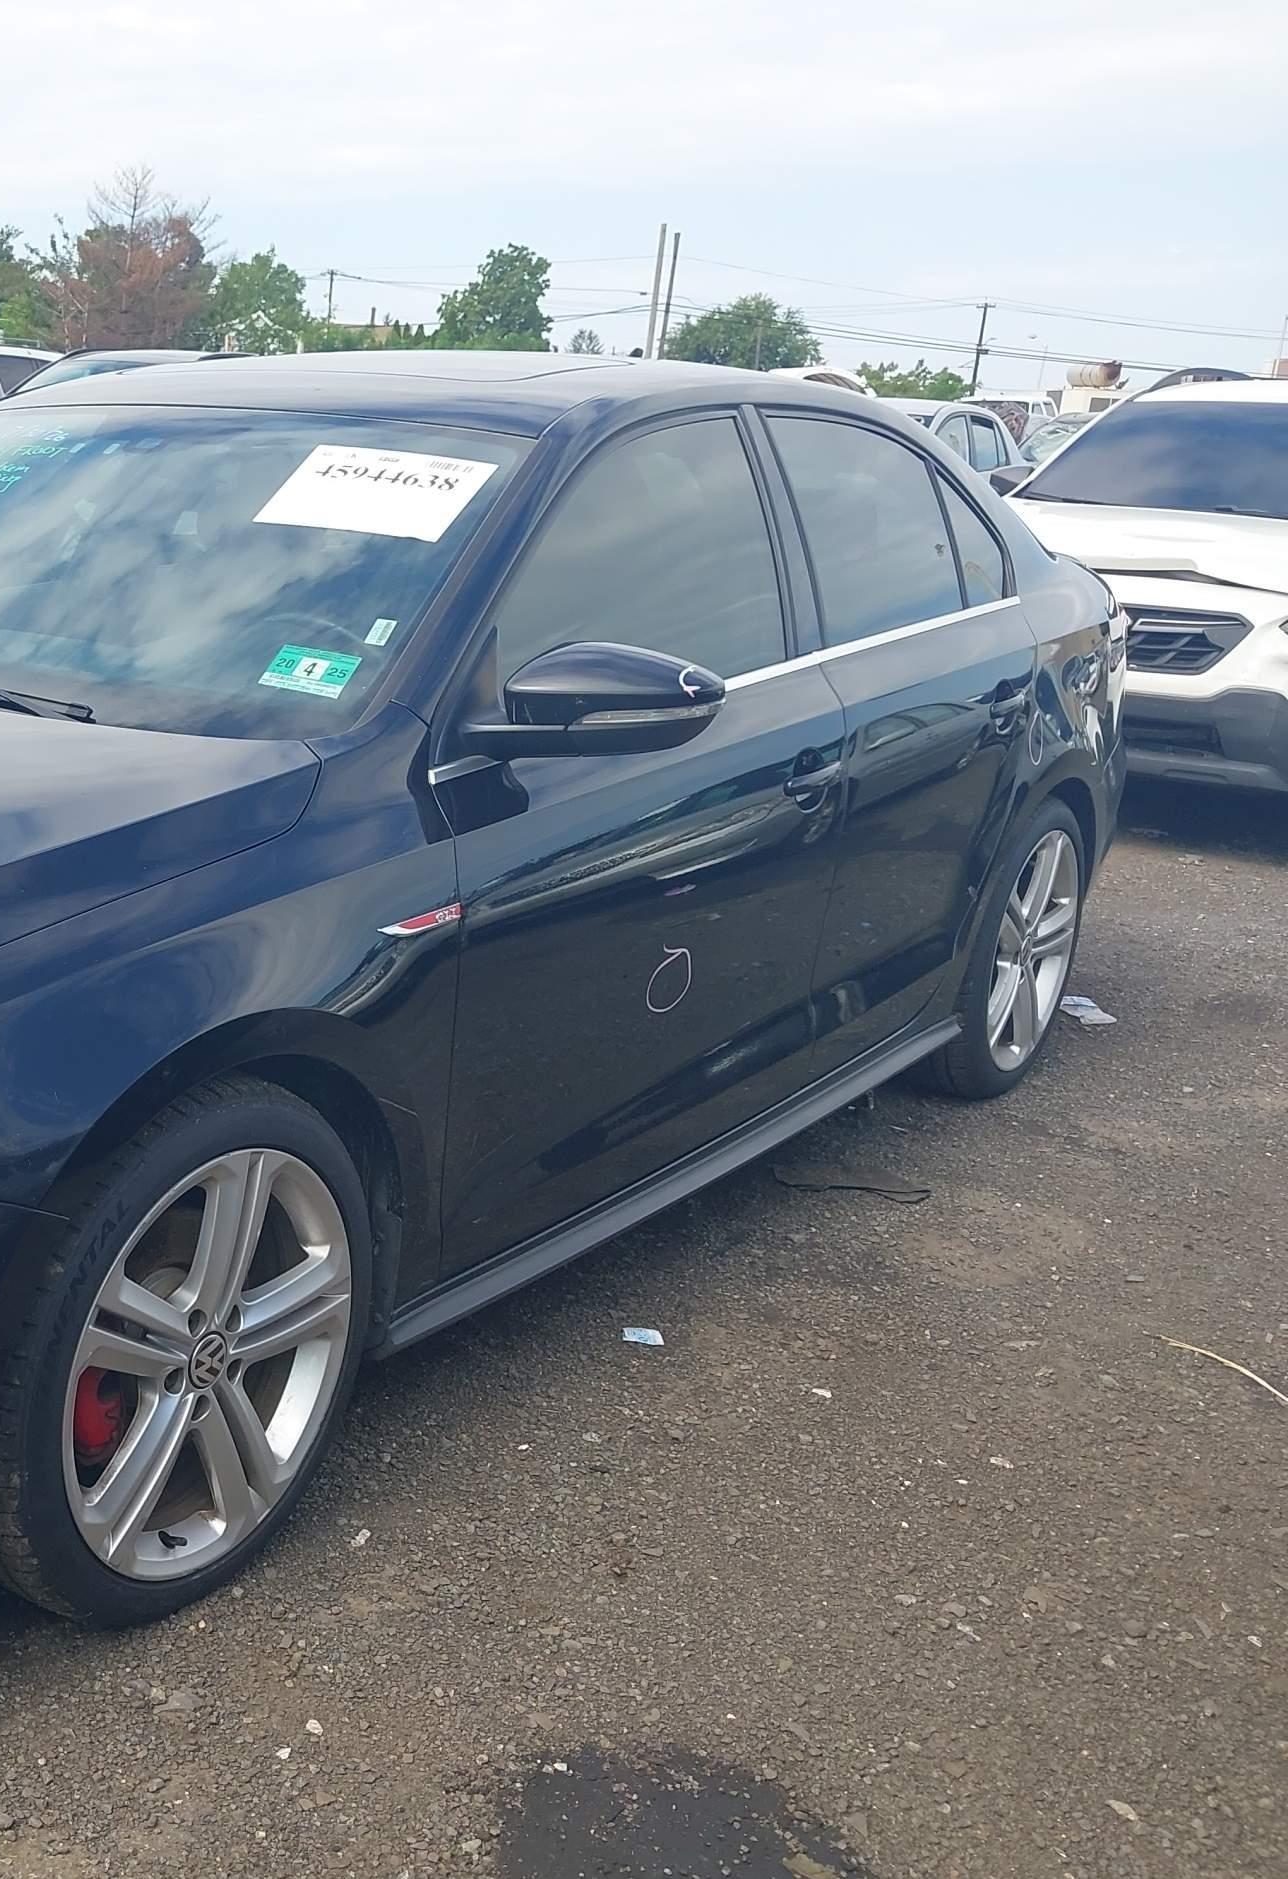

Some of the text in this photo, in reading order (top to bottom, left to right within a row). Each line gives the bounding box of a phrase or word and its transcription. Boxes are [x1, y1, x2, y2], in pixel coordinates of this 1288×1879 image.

[315, 463, 460, 491] 45944638
[275, 657, 349, 679] 20 4 25
